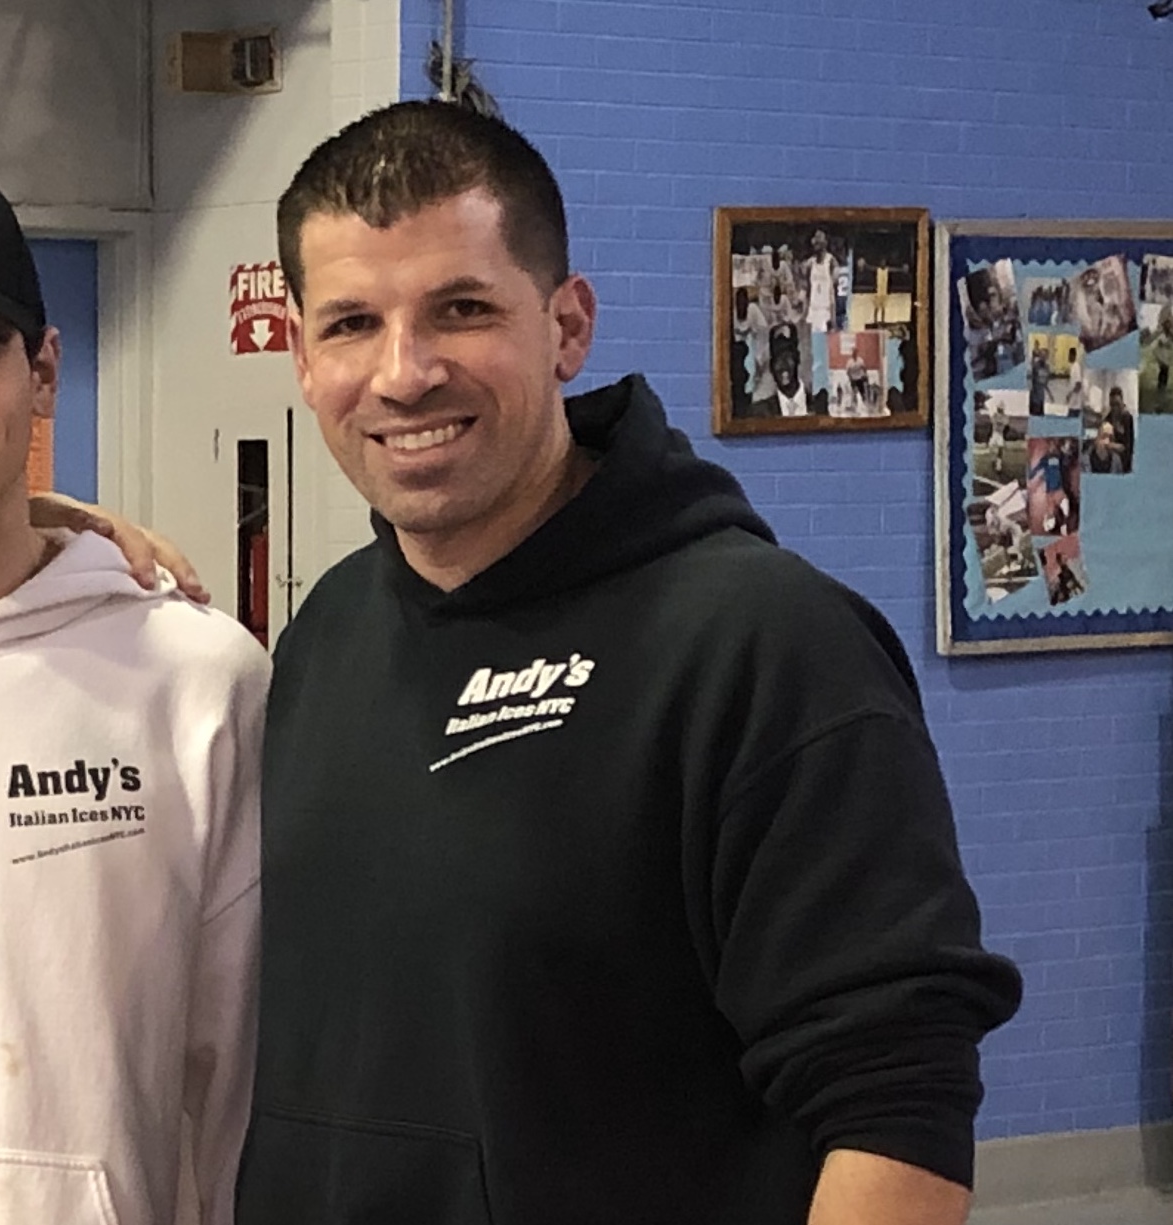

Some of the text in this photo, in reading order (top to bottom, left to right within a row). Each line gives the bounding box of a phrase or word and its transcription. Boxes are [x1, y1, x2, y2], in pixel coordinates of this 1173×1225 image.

[237, 269, 286, 302] FIRE
[457, 652, 596, 707] Andy's
[535, 697, 577, 717] NYC
[8, 757, 142, 802] Andy's
[9, 805, 146, 828] Italian Ices NYC
